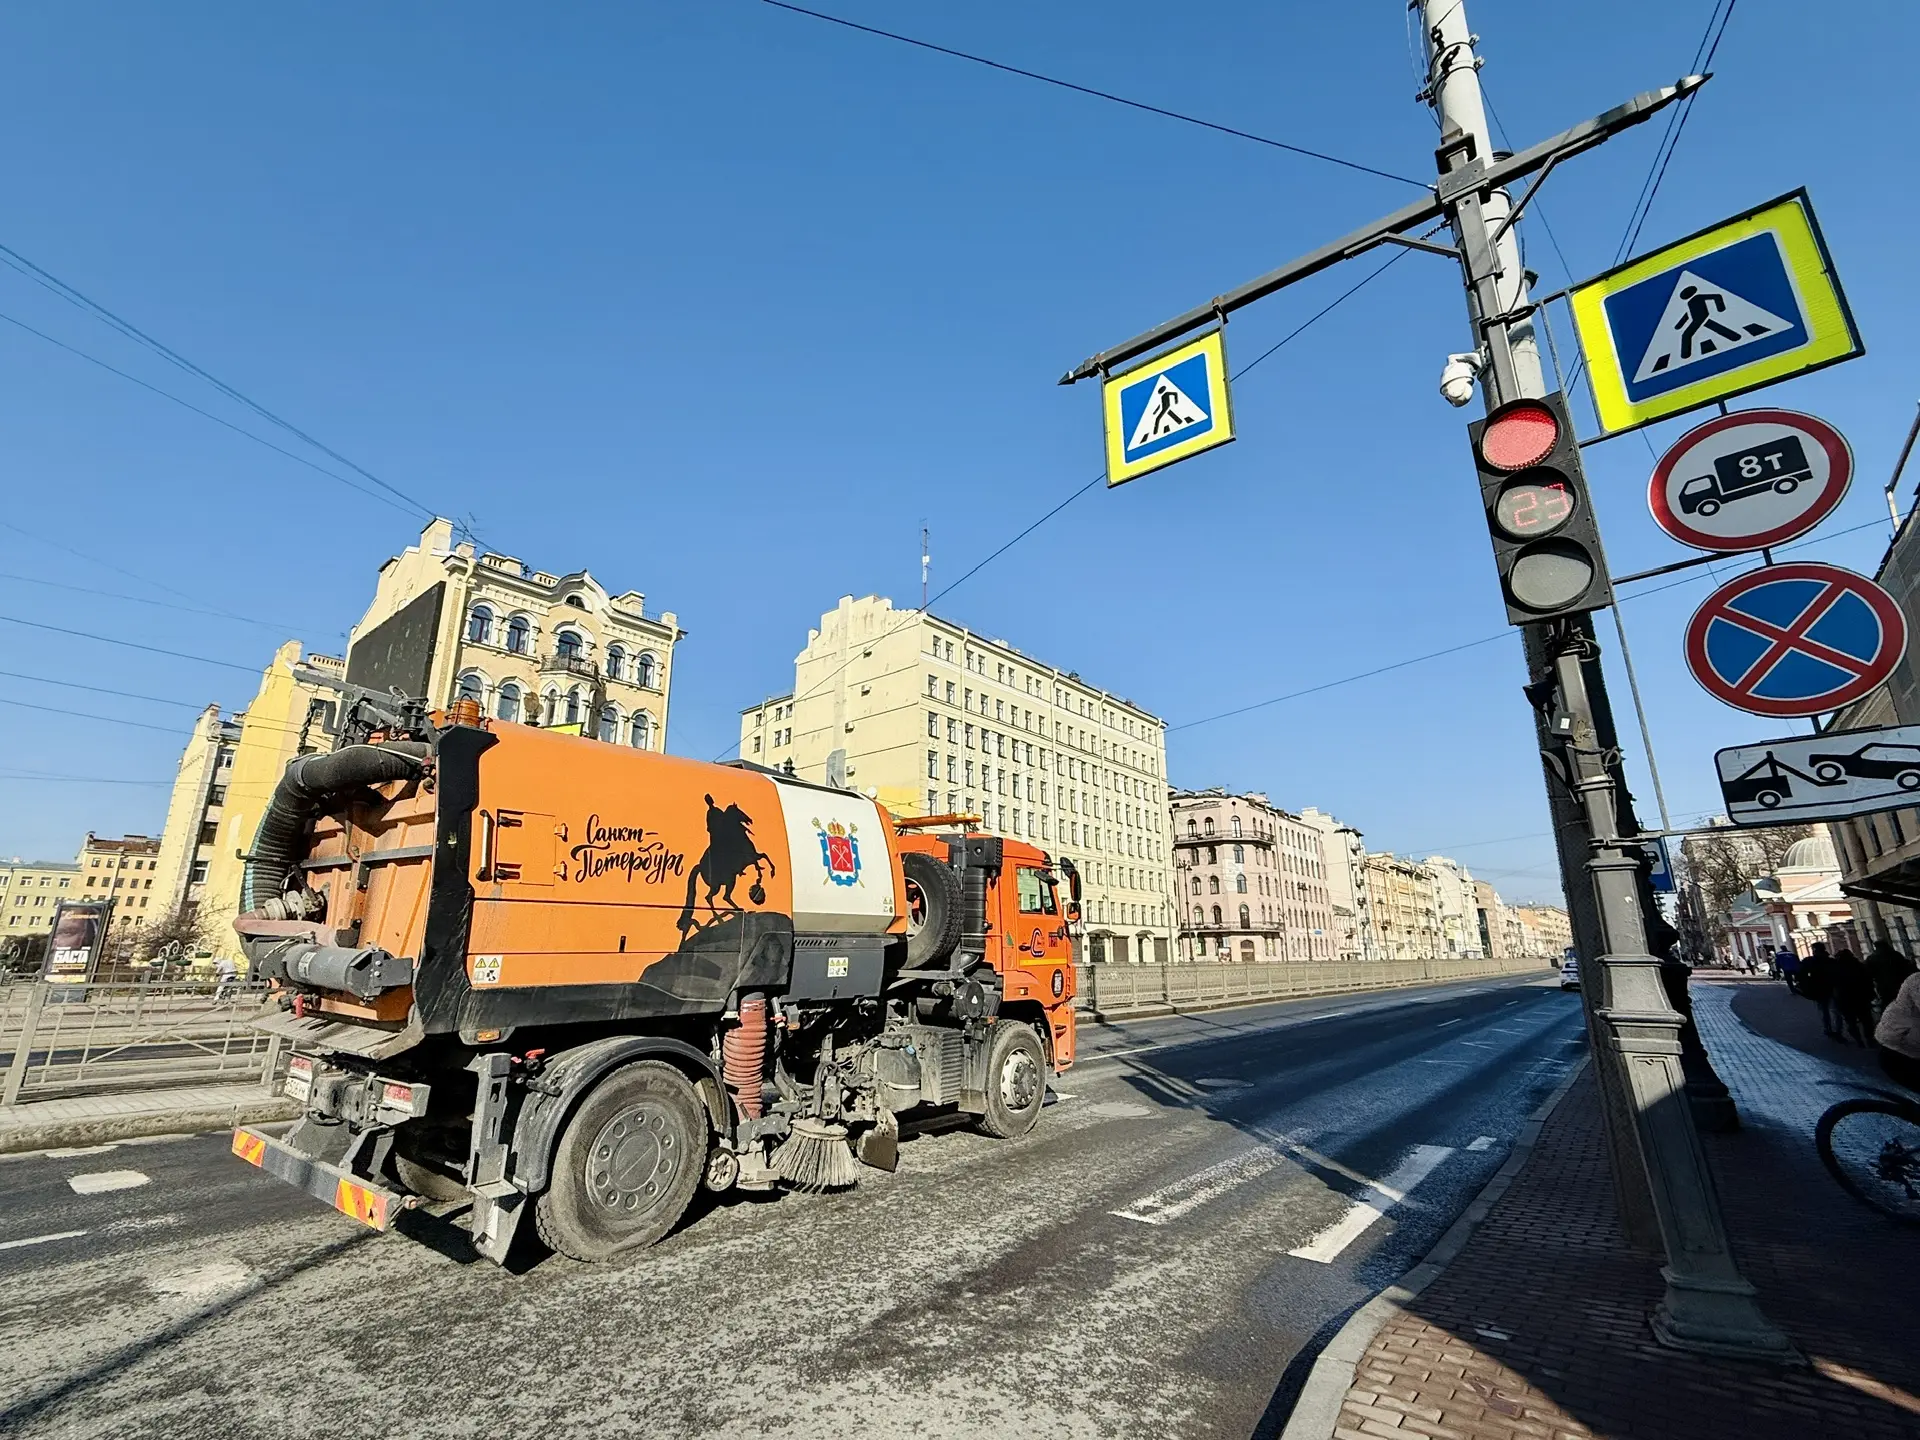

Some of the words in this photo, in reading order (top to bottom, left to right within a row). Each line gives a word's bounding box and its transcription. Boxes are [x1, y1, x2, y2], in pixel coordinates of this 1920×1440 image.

[1511, 483, 1571, 528] 23
[586, 813, 660, 845] Санкт-
[570, 841, 685, 885] Петербург
